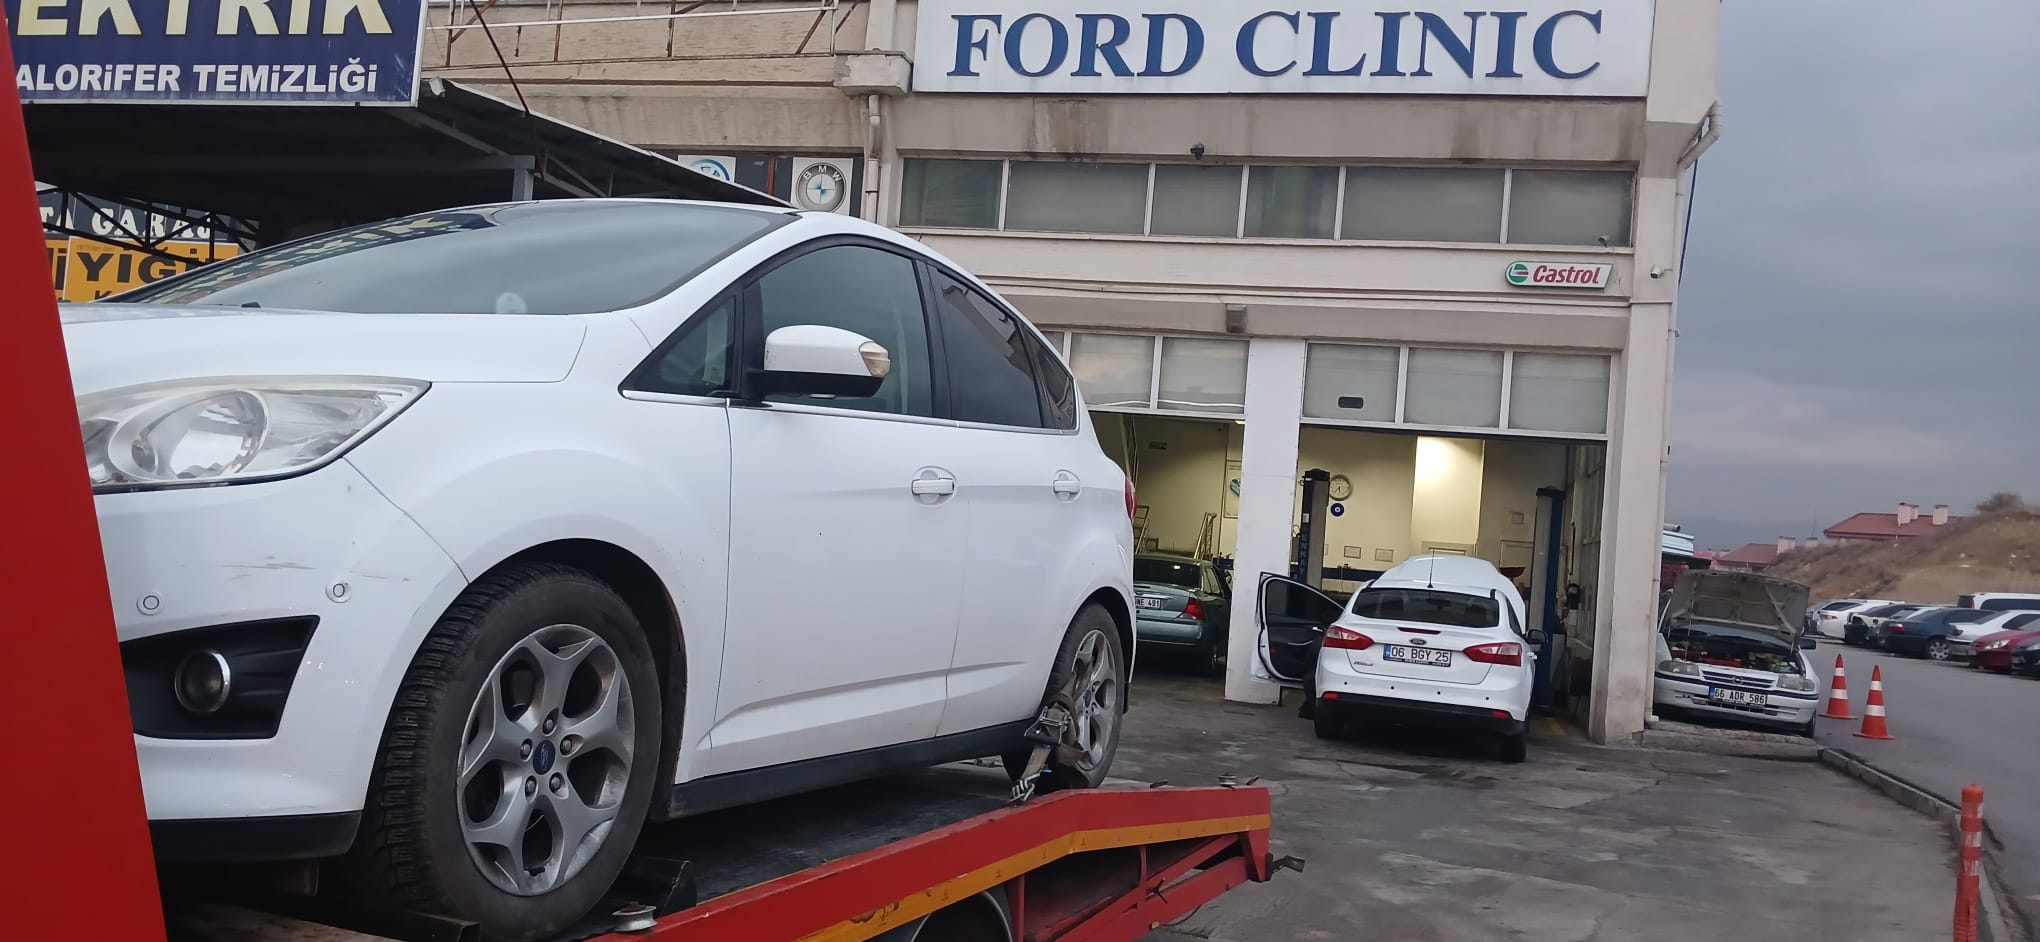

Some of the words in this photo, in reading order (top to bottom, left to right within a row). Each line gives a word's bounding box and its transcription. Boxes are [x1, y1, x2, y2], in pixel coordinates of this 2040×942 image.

[946, 13, 1205, 78] FORD
[1235, 11, 1602, 80] CLINIC
[803, 165, 842, 183] BMW
[1532, 264, 1602, 285] Castrol
[1148, 599, 1160, 608] 491
[1391, 646, 1405, 658] 06
[1411, 648, 1432, 661] BGY
[1435, 651, 1449, 663] 25
[1714, 688, 1725, 698] 66
[1729, 691, 1745, 701] ADR
[1749, 694, 1765, 704] 586
